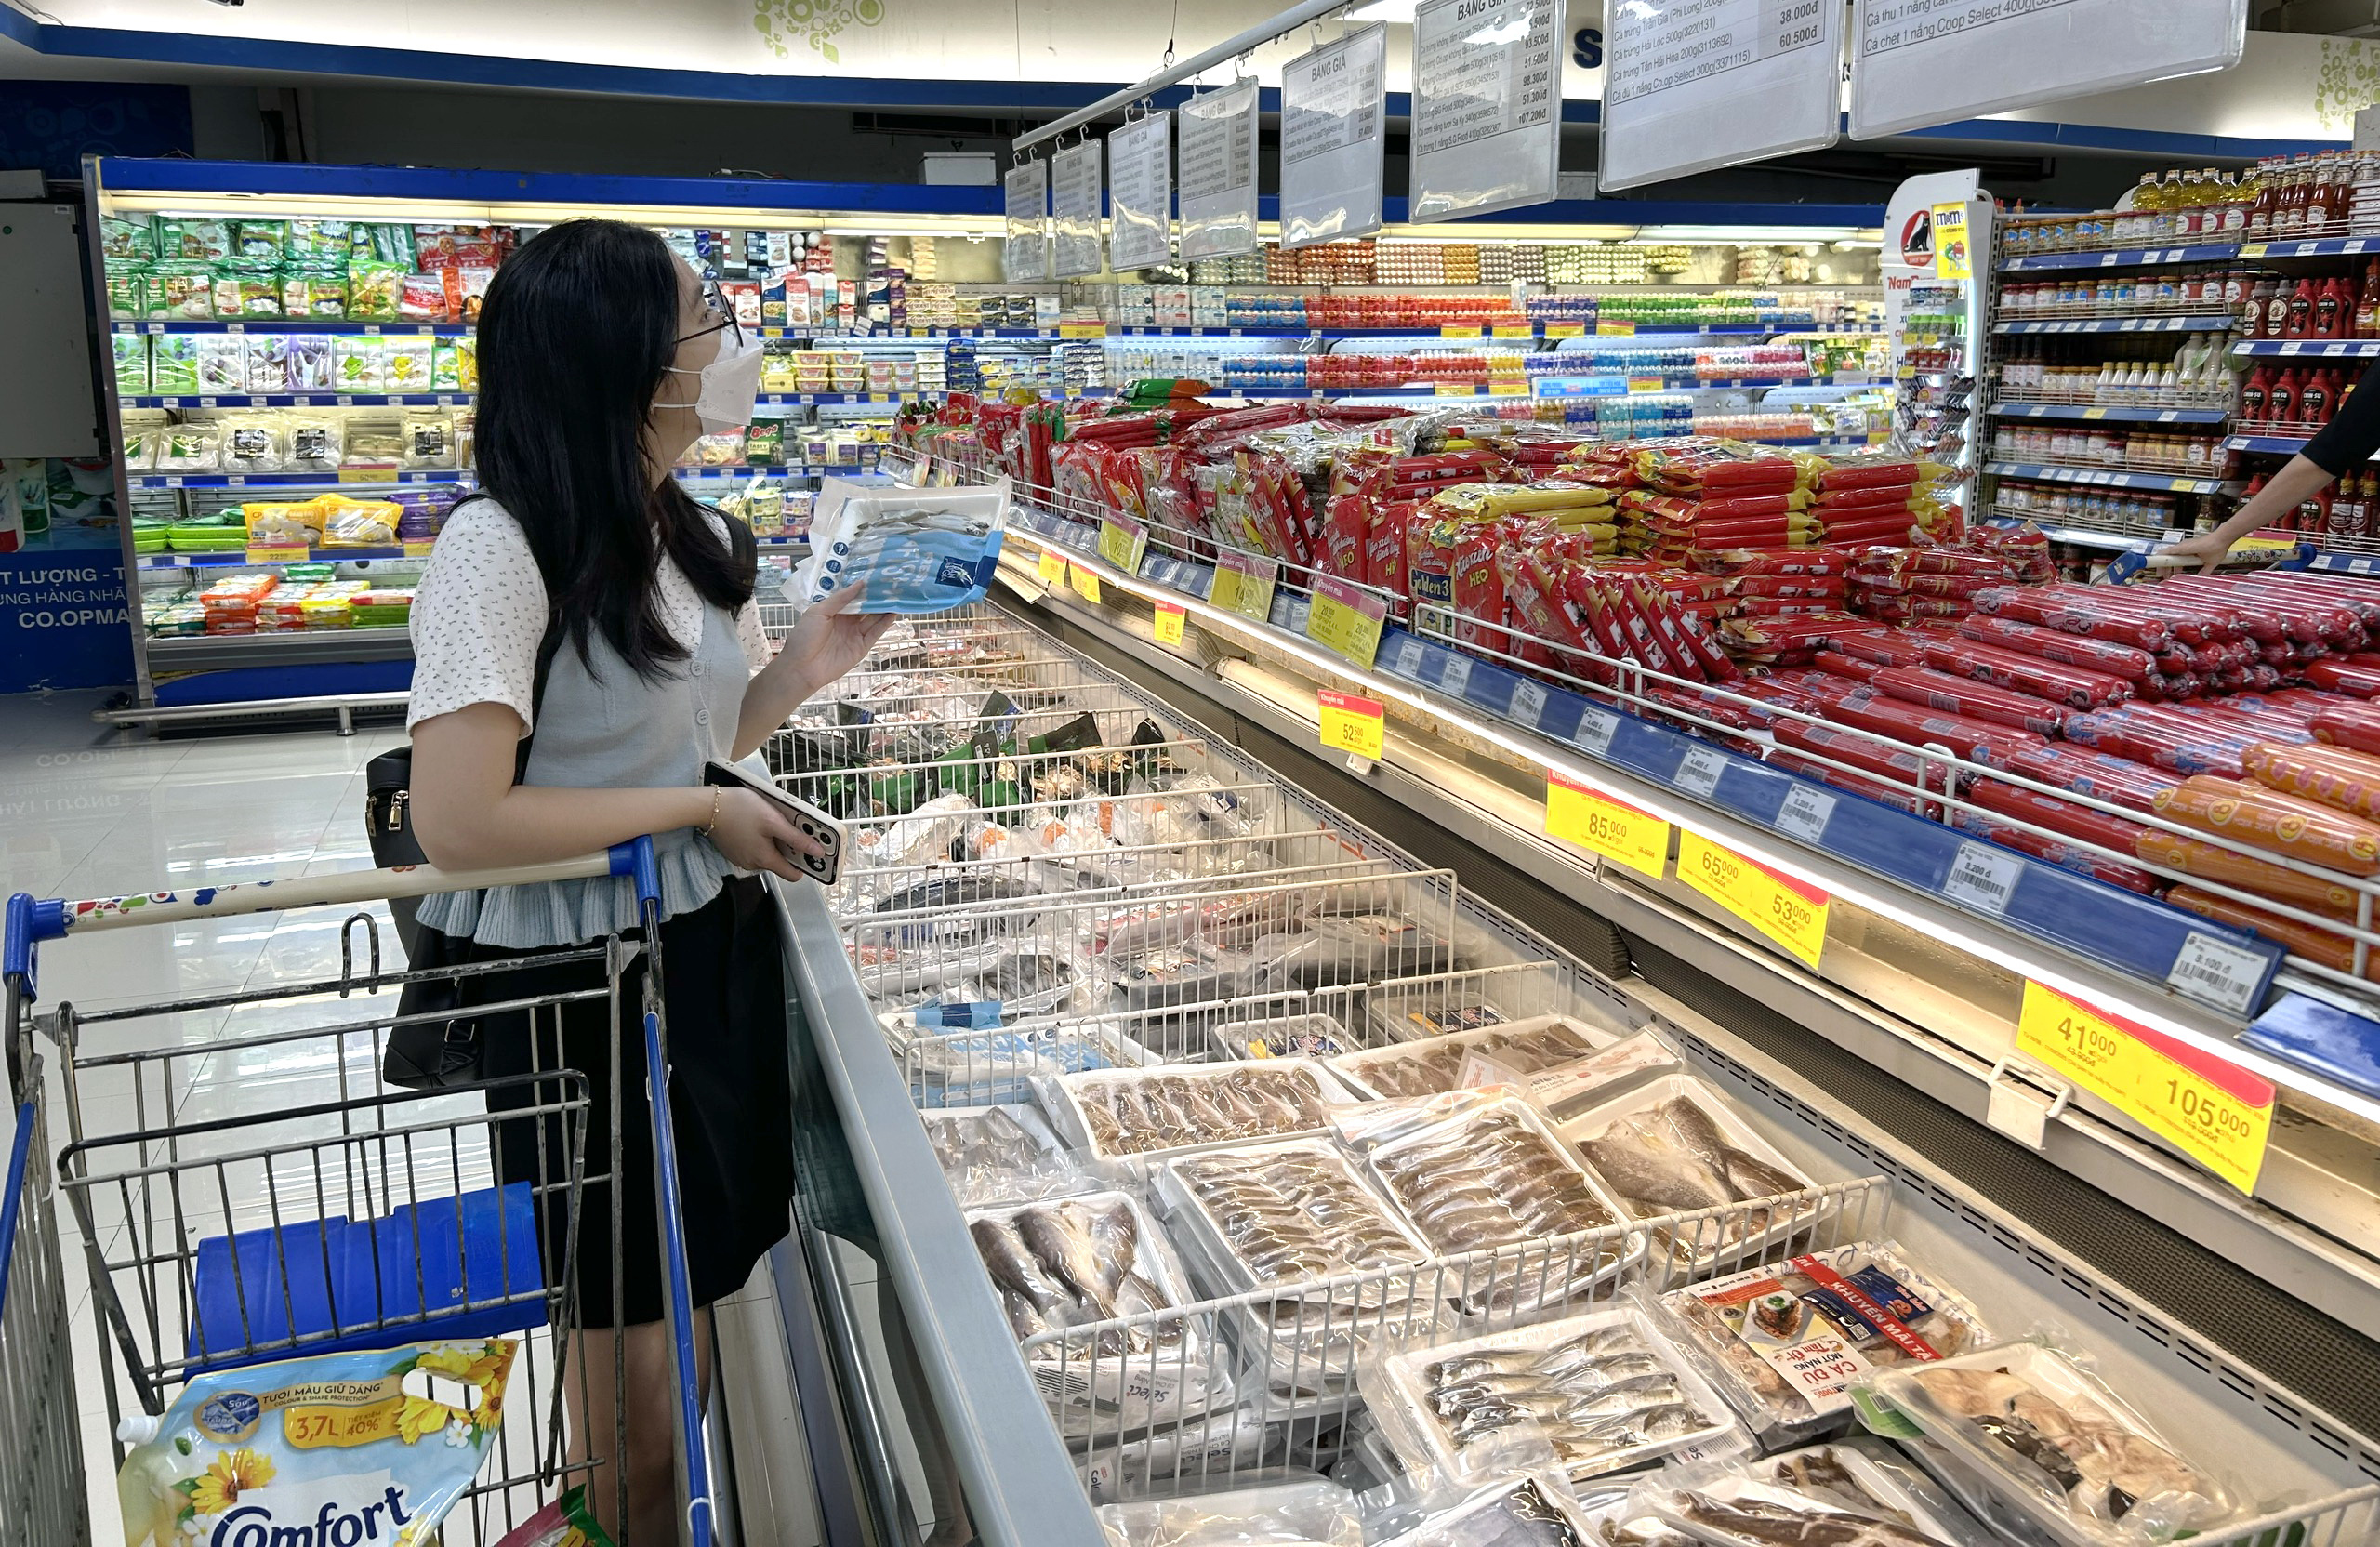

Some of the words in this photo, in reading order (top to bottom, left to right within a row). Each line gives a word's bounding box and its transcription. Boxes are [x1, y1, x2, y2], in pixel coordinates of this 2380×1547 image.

[1780, 0, 1818, 25] 38.000đ
[1866, 11, 1880, 27] Cá
[1882, 8, 1897, 22] thu
[1865, 38, 1878, 52] Cá
[1910, 22, 1935, 41] nắng
[1937, 13, 1965, 33] Coop
[1967, 4, 2002, 24] Select
[1673, 69, 1695, 84] Select
[1779, 24, 1818, 48] 60.500đ
[1888, 275, 1919, 290] Nam
[750, 424, 778, 439] Bega
[19, 568, 97, 587] LƯỢNG
[1411, 568, 1440, 597] Golden
[1441, 581, 1450, 596] 3
[1469, 569, 1489, 588] HEO
[35, 588, 86, 604] HÀNG
[90, 586, 126, 602] NHÃ
[19, 608, 130, 628] CO.OPMA
[2167, 1079, 2215, 1127] 105
[1830, 1281, 1887, 1324] KHUYẾN
[1883, 1323, 1913, 1346] MÃI
[1822, 1352, 1844, 1365] MỘT
[1829, 1360, 1858, 1376] CÁ
[1802, 1368, 1830, 1385] ĐÙ
[228, 1398, 248, 1408] Sau
[263, 1390, 291, 1404] TƯƠI
[294, 1383, 322, 1396] MÀU
[324, 1383, 346, 1395] GIỮ
[274, 1395, 301, 1407] COLOUR
[295, 1416, 339, 1441] 3,7L
[210, 1487, 413, 1547] Comfort
